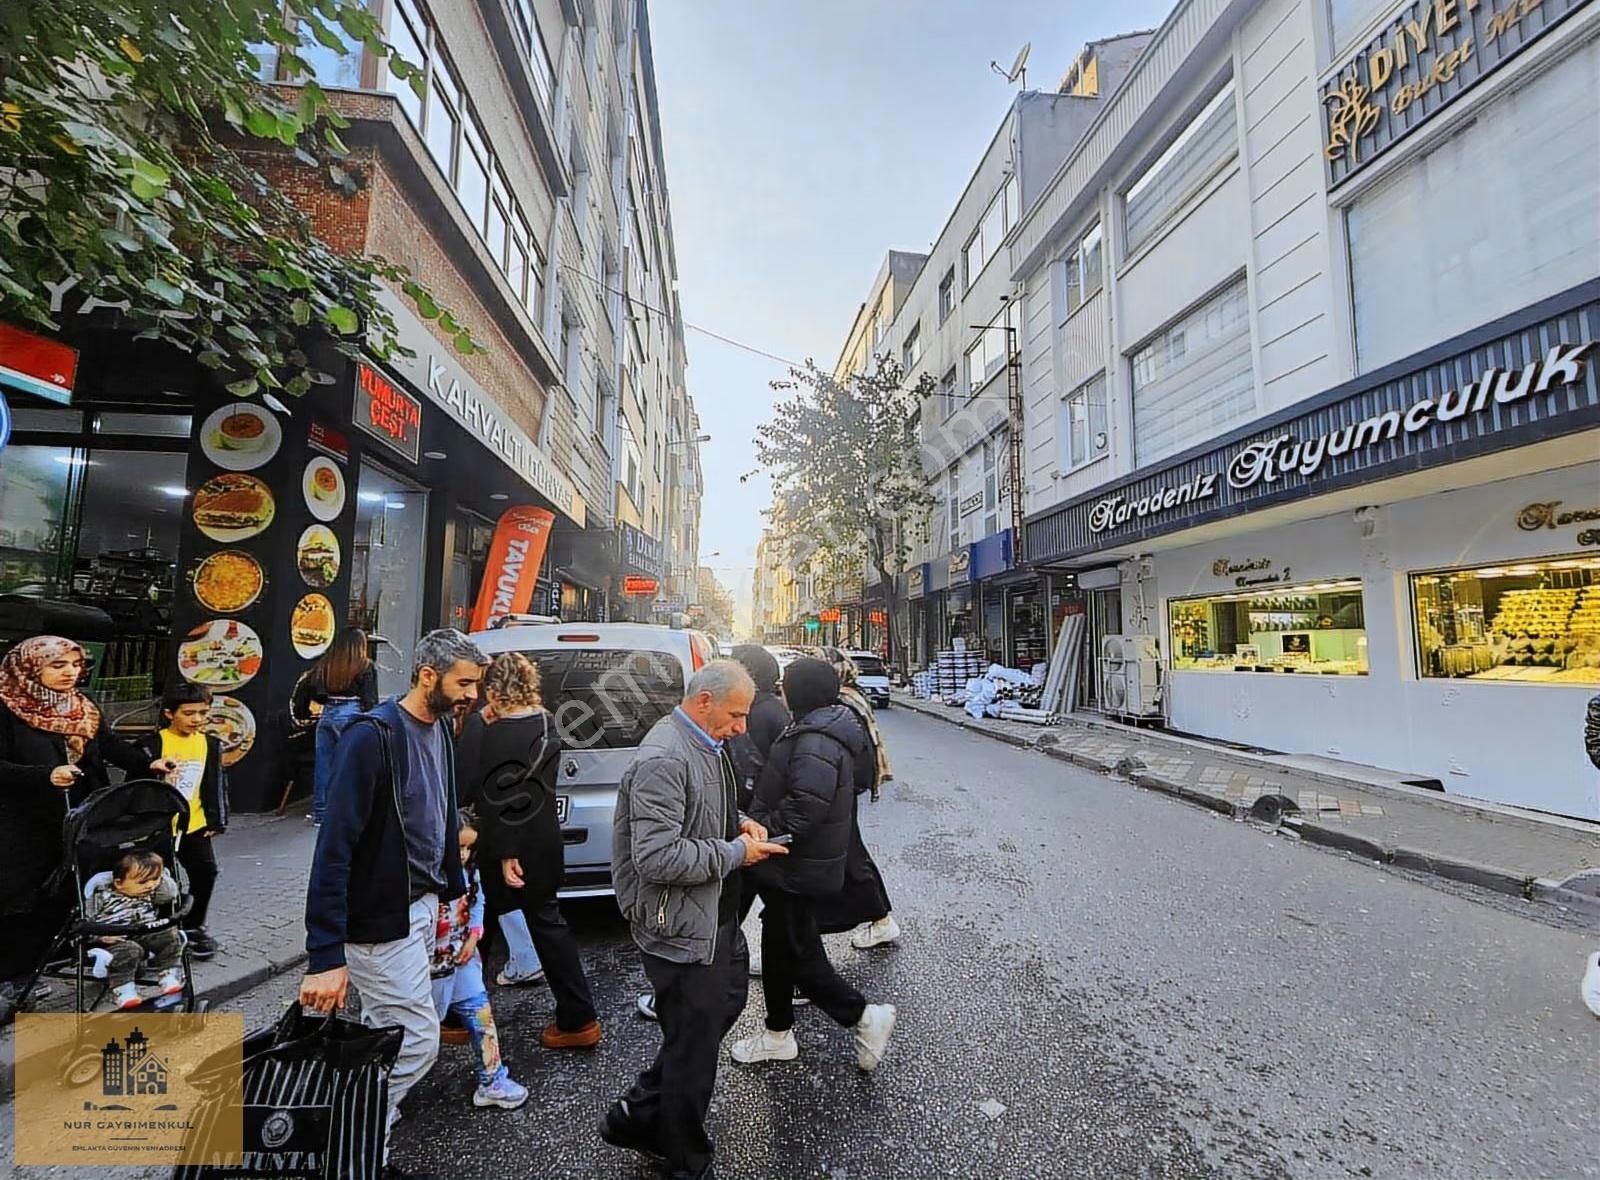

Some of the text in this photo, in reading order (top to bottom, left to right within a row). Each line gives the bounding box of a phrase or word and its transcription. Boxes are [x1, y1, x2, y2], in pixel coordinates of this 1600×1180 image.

[360, 364, 418, 428] YUMURTA
[427, 354, 525, 469] KAHVALTI
[1088, 343, 1598, 533] Karadeniz Kuyumculuk
